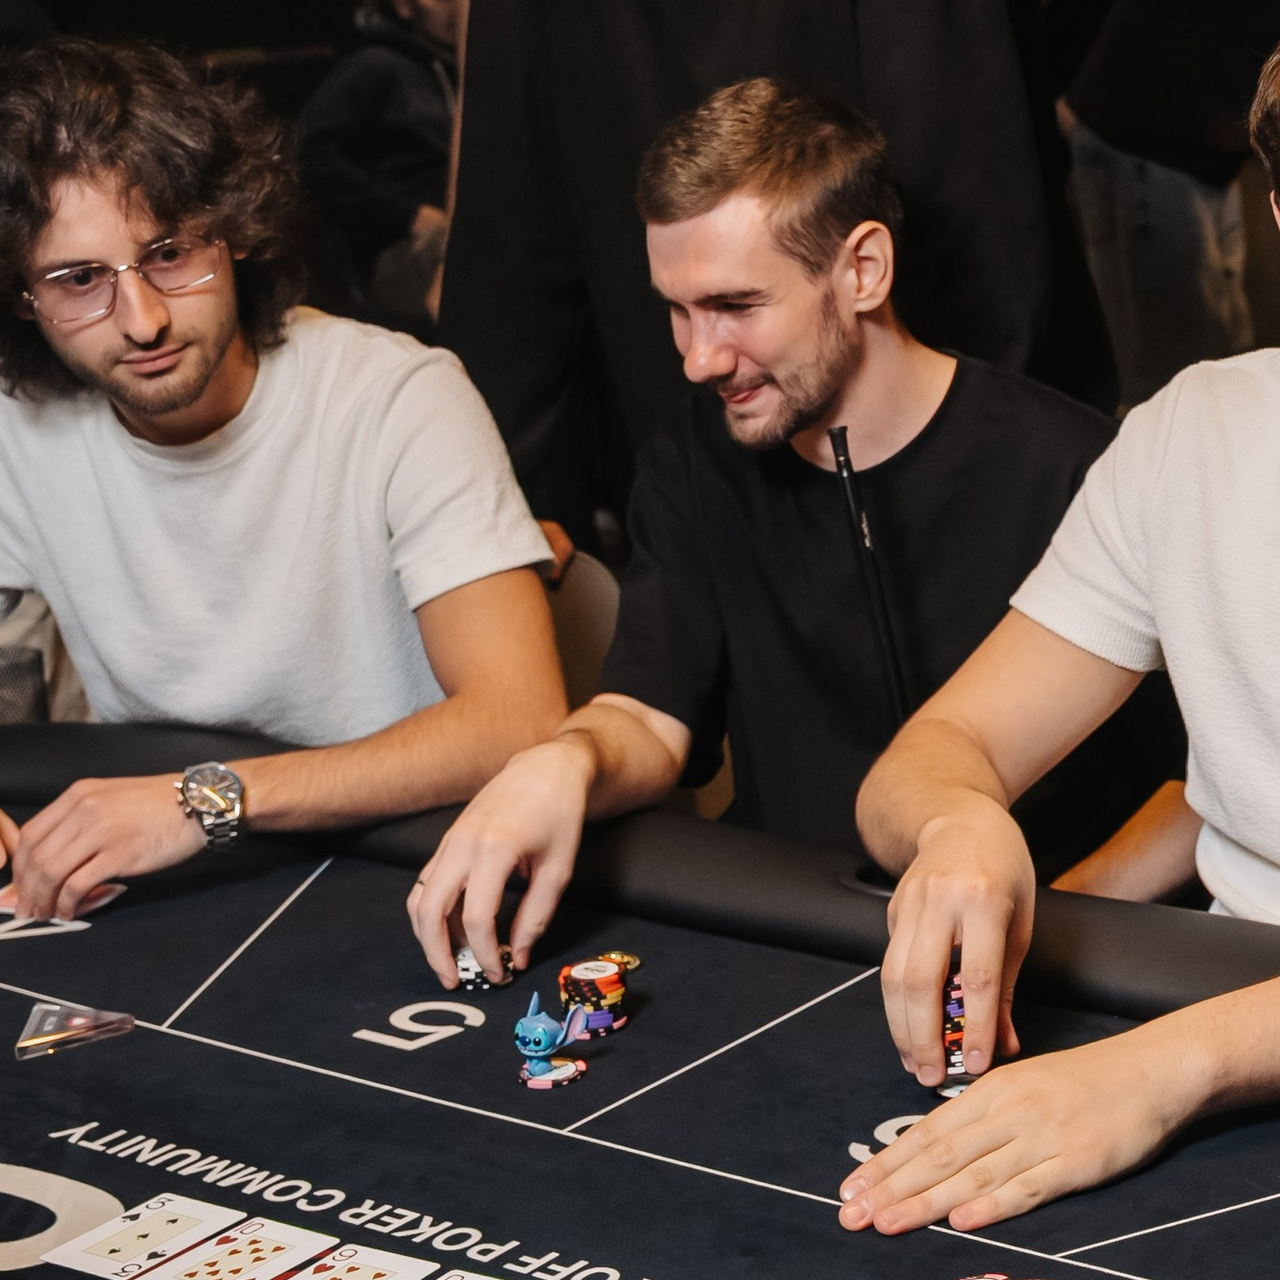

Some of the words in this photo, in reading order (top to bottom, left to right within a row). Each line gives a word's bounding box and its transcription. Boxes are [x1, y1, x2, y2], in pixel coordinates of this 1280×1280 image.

[352, 1000, 486, 1052] 5
[48, 1121, 346, 1212] COMMUNITY
[233, 1220, 265, 1235] 10
[338, 1198, 520, 1262] POKER
